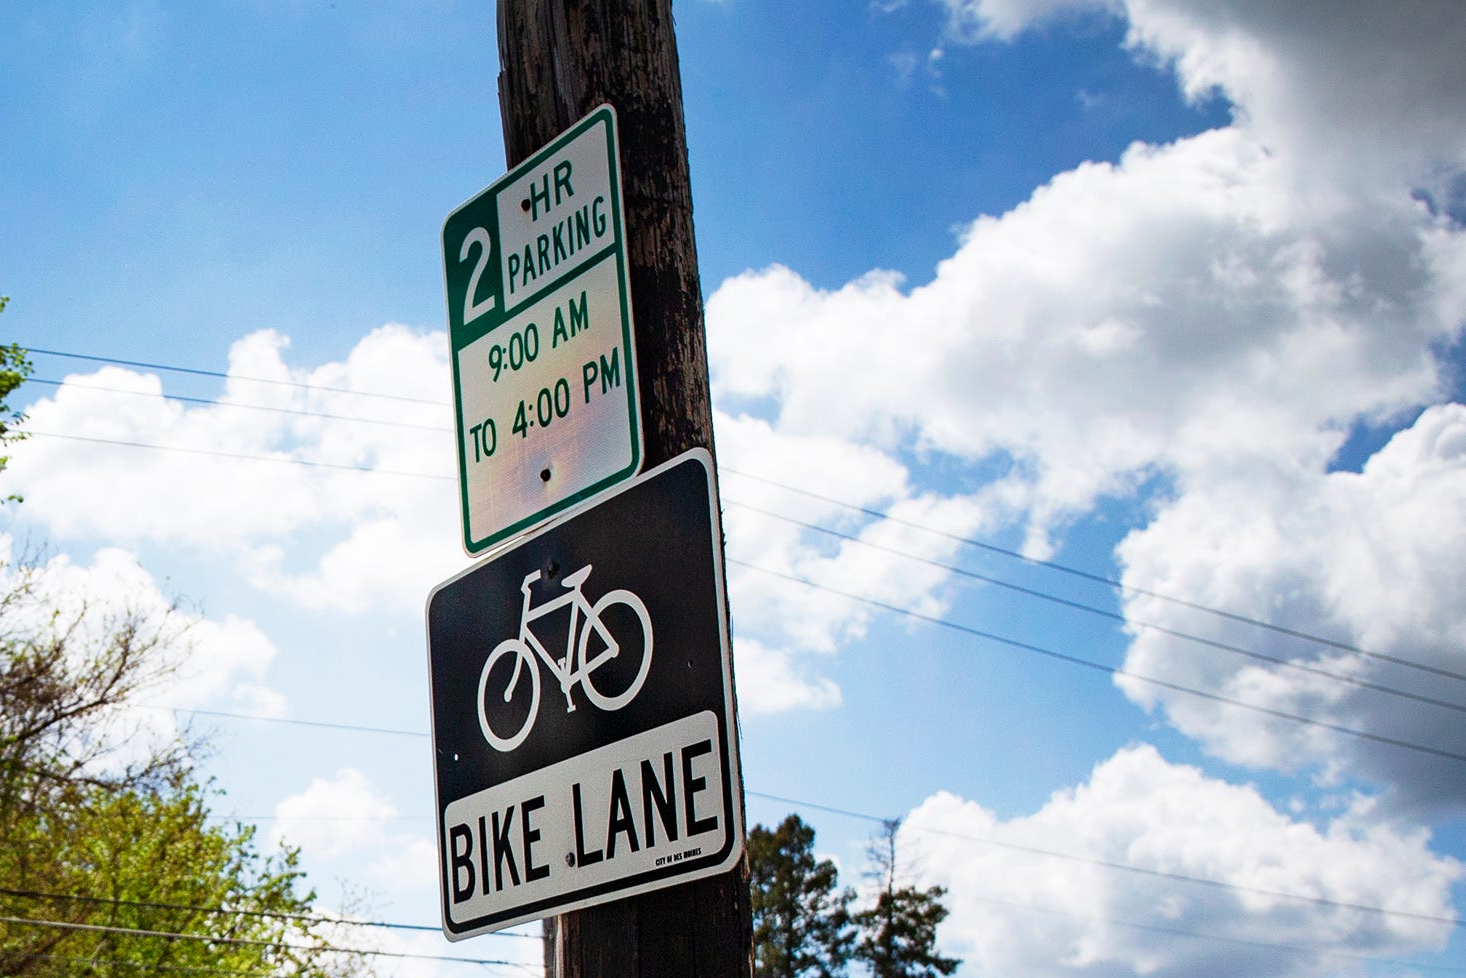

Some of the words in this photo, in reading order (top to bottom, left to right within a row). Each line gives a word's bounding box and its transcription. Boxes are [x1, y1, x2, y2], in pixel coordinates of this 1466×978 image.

[529, 159, 575, 222] HR
[458, 227, 495, 326] 2
[507, 195, 607, 295] PARKING
[488, 322, 540, 383] 9:00
[551, 291, 589, 349] AM
[469, 418, 497, 463] TO
[511, 378, 570, 439] 4:00
[582, 347, 621, 404] PM
[449, 795, 550, 905] BIKE
[571, 739, 719, 868] LANE
